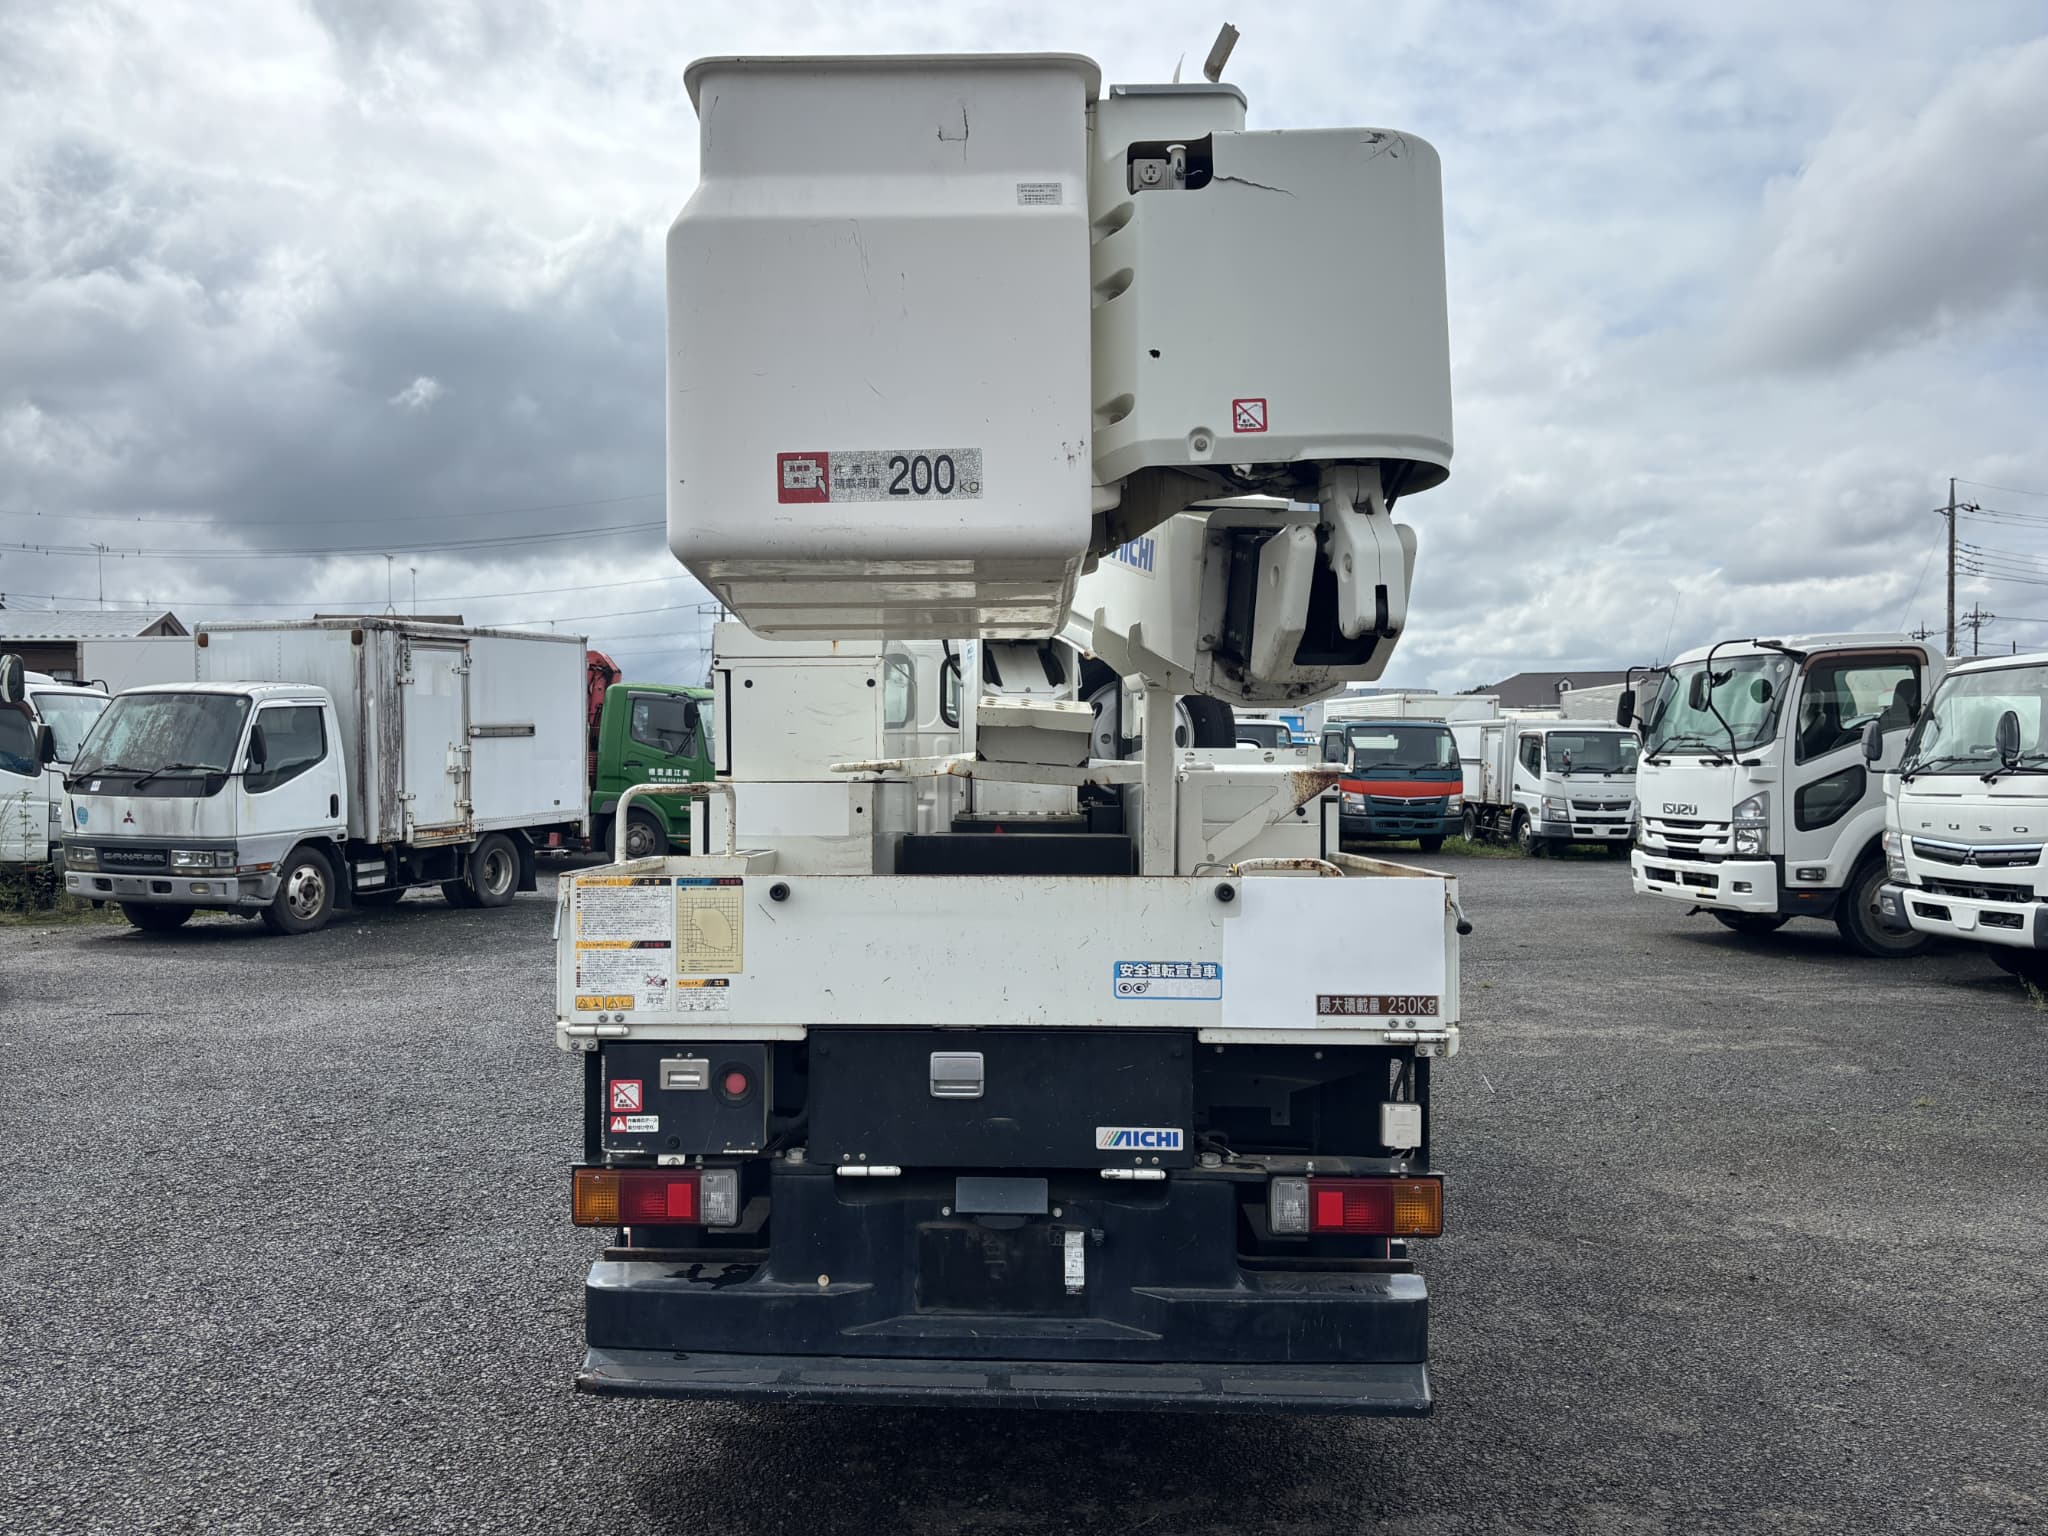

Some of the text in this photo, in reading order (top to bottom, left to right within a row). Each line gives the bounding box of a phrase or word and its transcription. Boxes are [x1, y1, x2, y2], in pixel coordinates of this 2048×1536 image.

[1662, 802, 1698, 816] ISUZU
[1921, 822, 2029, 833] FUSO
[103, 852, 166, 863] CANTER
[1119, 963, 1217, 978] 安全運転宣言車
[1319, 996, 1436, 1014] 最大積載量 250Kg
[1112, 1130, 1179, 1147] AICHI
